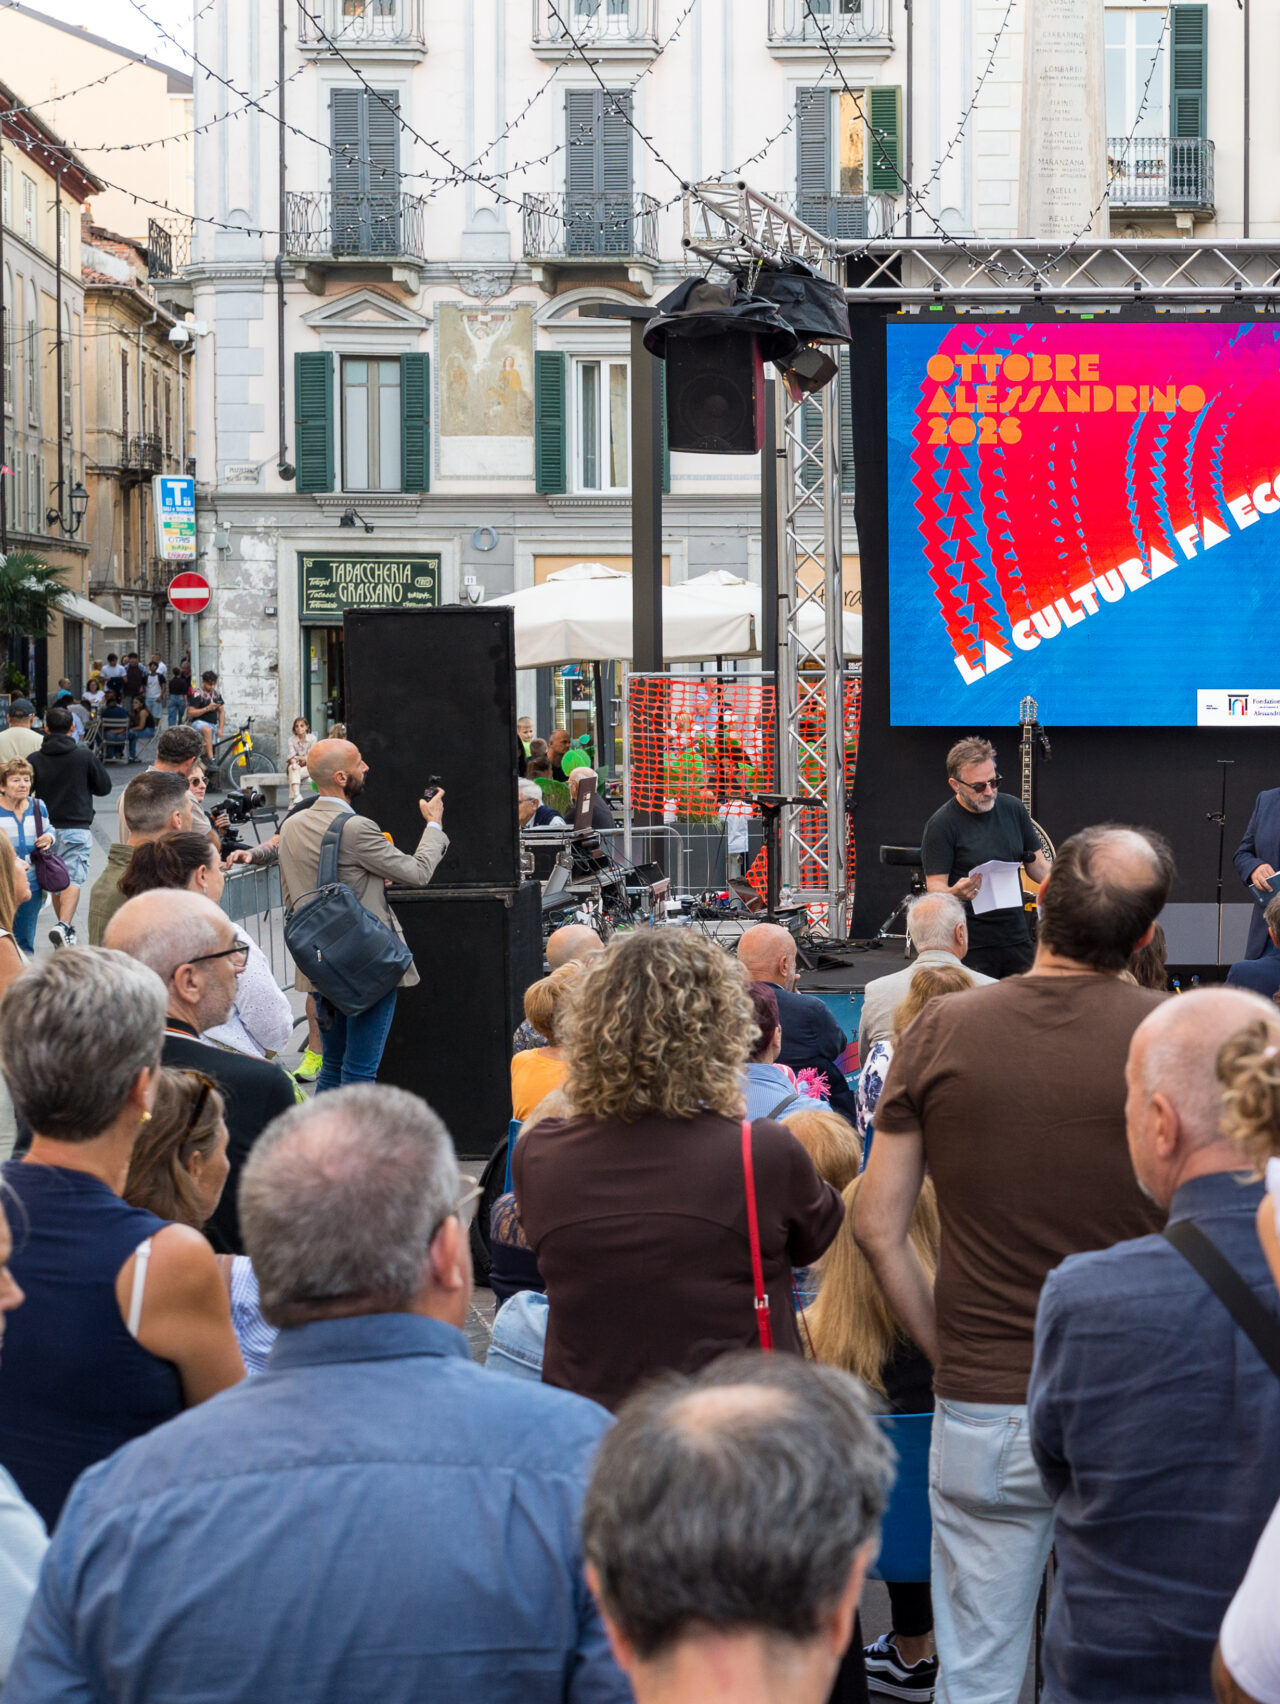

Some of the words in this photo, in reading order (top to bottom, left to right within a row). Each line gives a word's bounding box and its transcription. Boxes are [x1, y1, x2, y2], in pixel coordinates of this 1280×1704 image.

[926, 353, 1100, 382] OTTOBRE
[926, 384, 1206, 413] ALESSANDRINO
[926, 416, 1023, 444] 2026
[167, 481, 188, 506] T
[329, 563, 411, 583] TABACCHERIA
[339, 583, 403, 602] GRASSANO
[953, 638, 1013, 686] LA
[1011, 545, 1179, 651] CULTURA
[1174, 515, 1231, 560] FA
